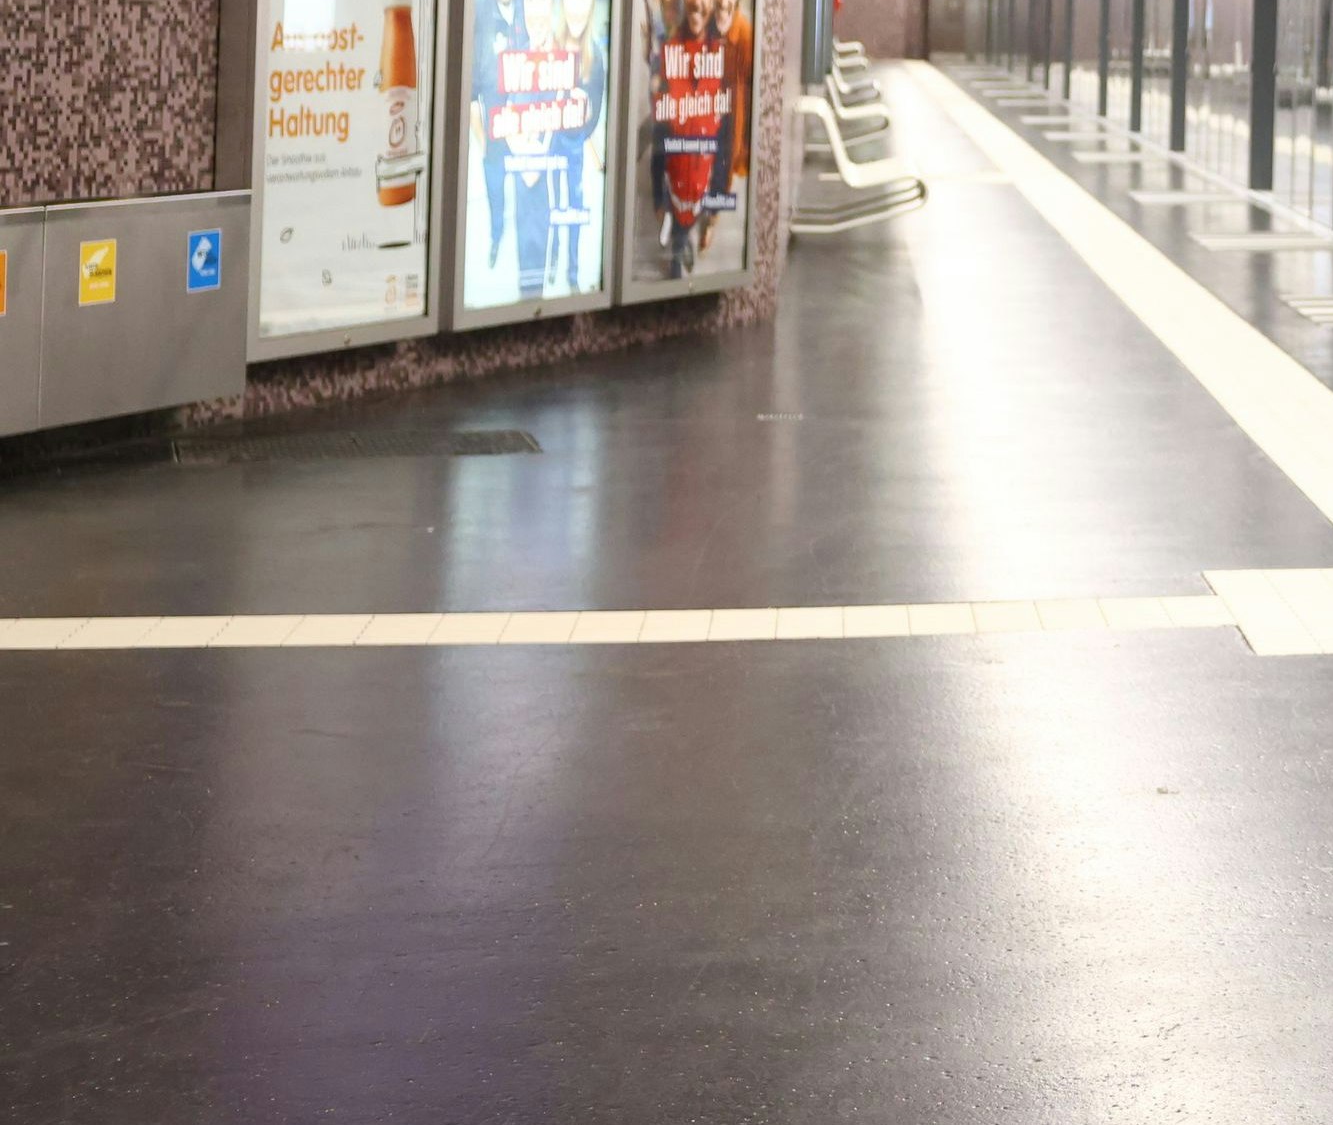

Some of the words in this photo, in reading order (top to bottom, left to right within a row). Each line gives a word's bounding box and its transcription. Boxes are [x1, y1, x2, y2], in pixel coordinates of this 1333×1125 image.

[269, 60, 366, 102] gerechter
[502, 52, 536, 92] Wir
[538, 51, 575, 92] sind
[664, 44, 691, 79] Wir
[693, 43, 725, 79] sind
[268, 104, 350, 144] Haltung
[655, 93, 676, 122] alle
[678, 89, 712, 125] gleich
